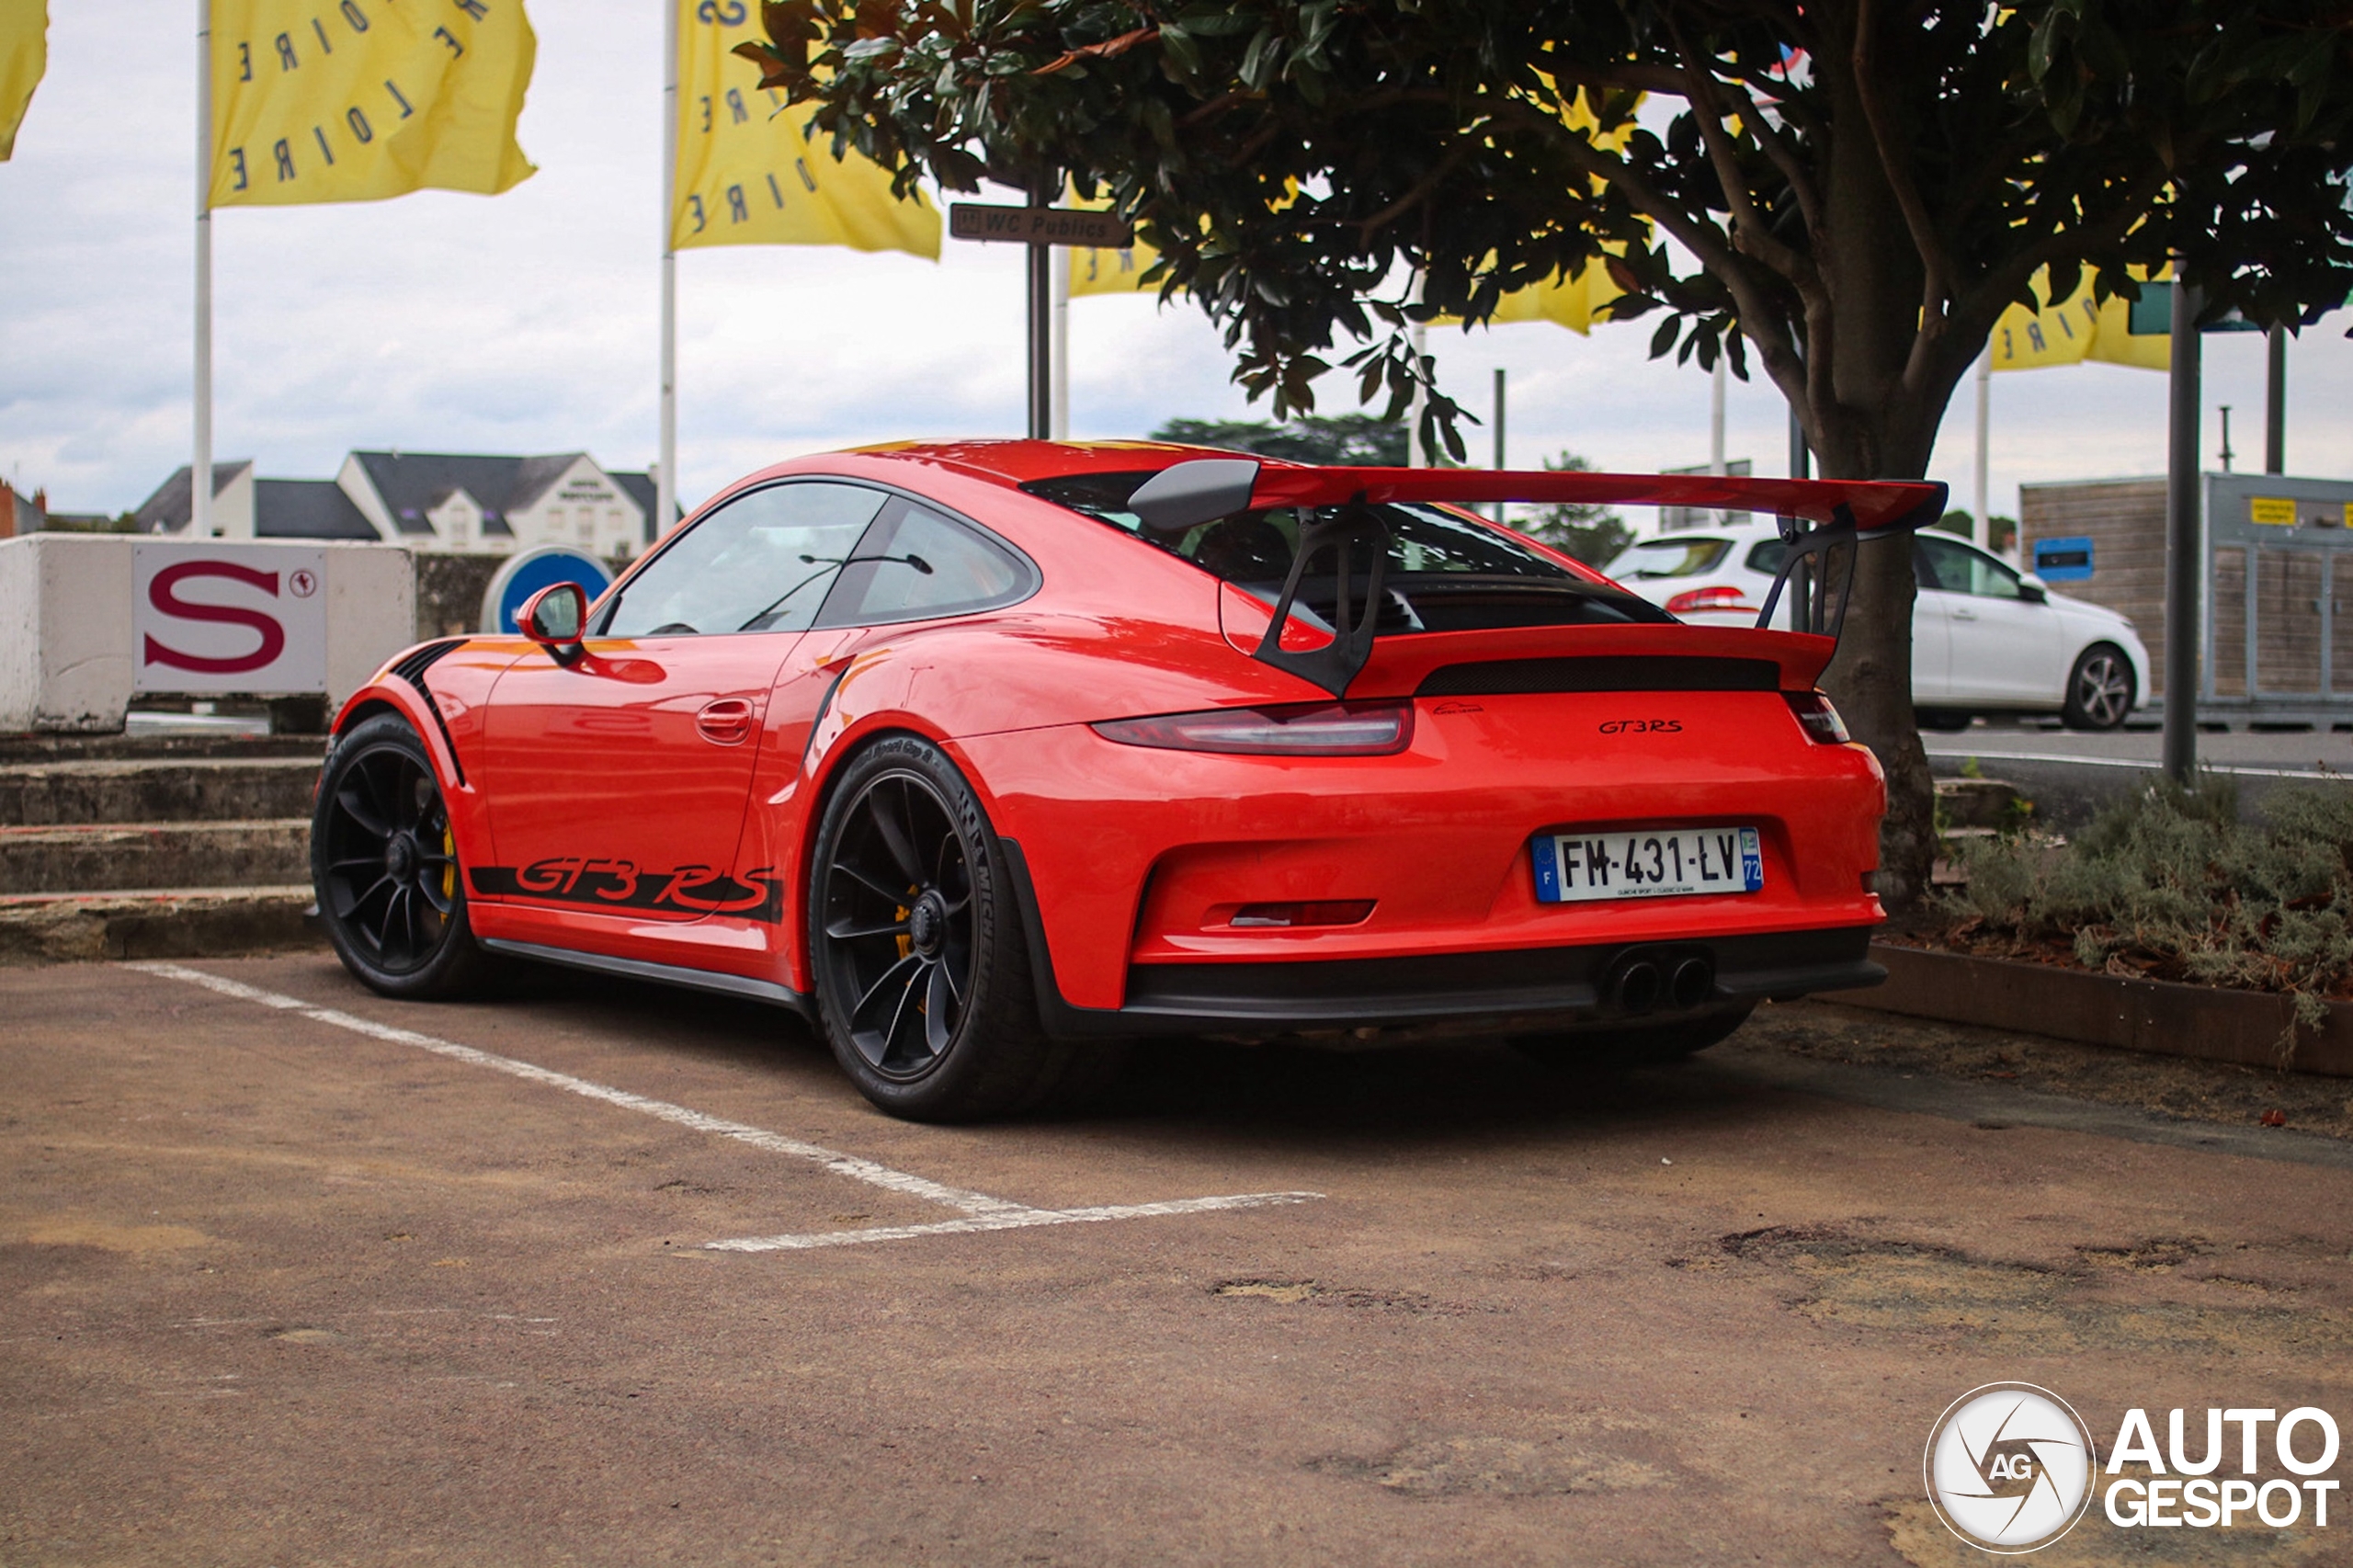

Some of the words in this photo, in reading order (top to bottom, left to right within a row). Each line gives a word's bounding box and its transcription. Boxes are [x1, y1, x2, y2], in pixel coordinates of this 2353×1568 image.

[985, 212, 1020, 233] WC
[1031, 216, 1108, 239] Publics
[144, 560, 285, 675] S
[1543, 871, 1551, 884] F
[1744, 859, 1761, 881] 72
[515, 856, 642, 902] GT3
[653, 864, 775, 913] RS
